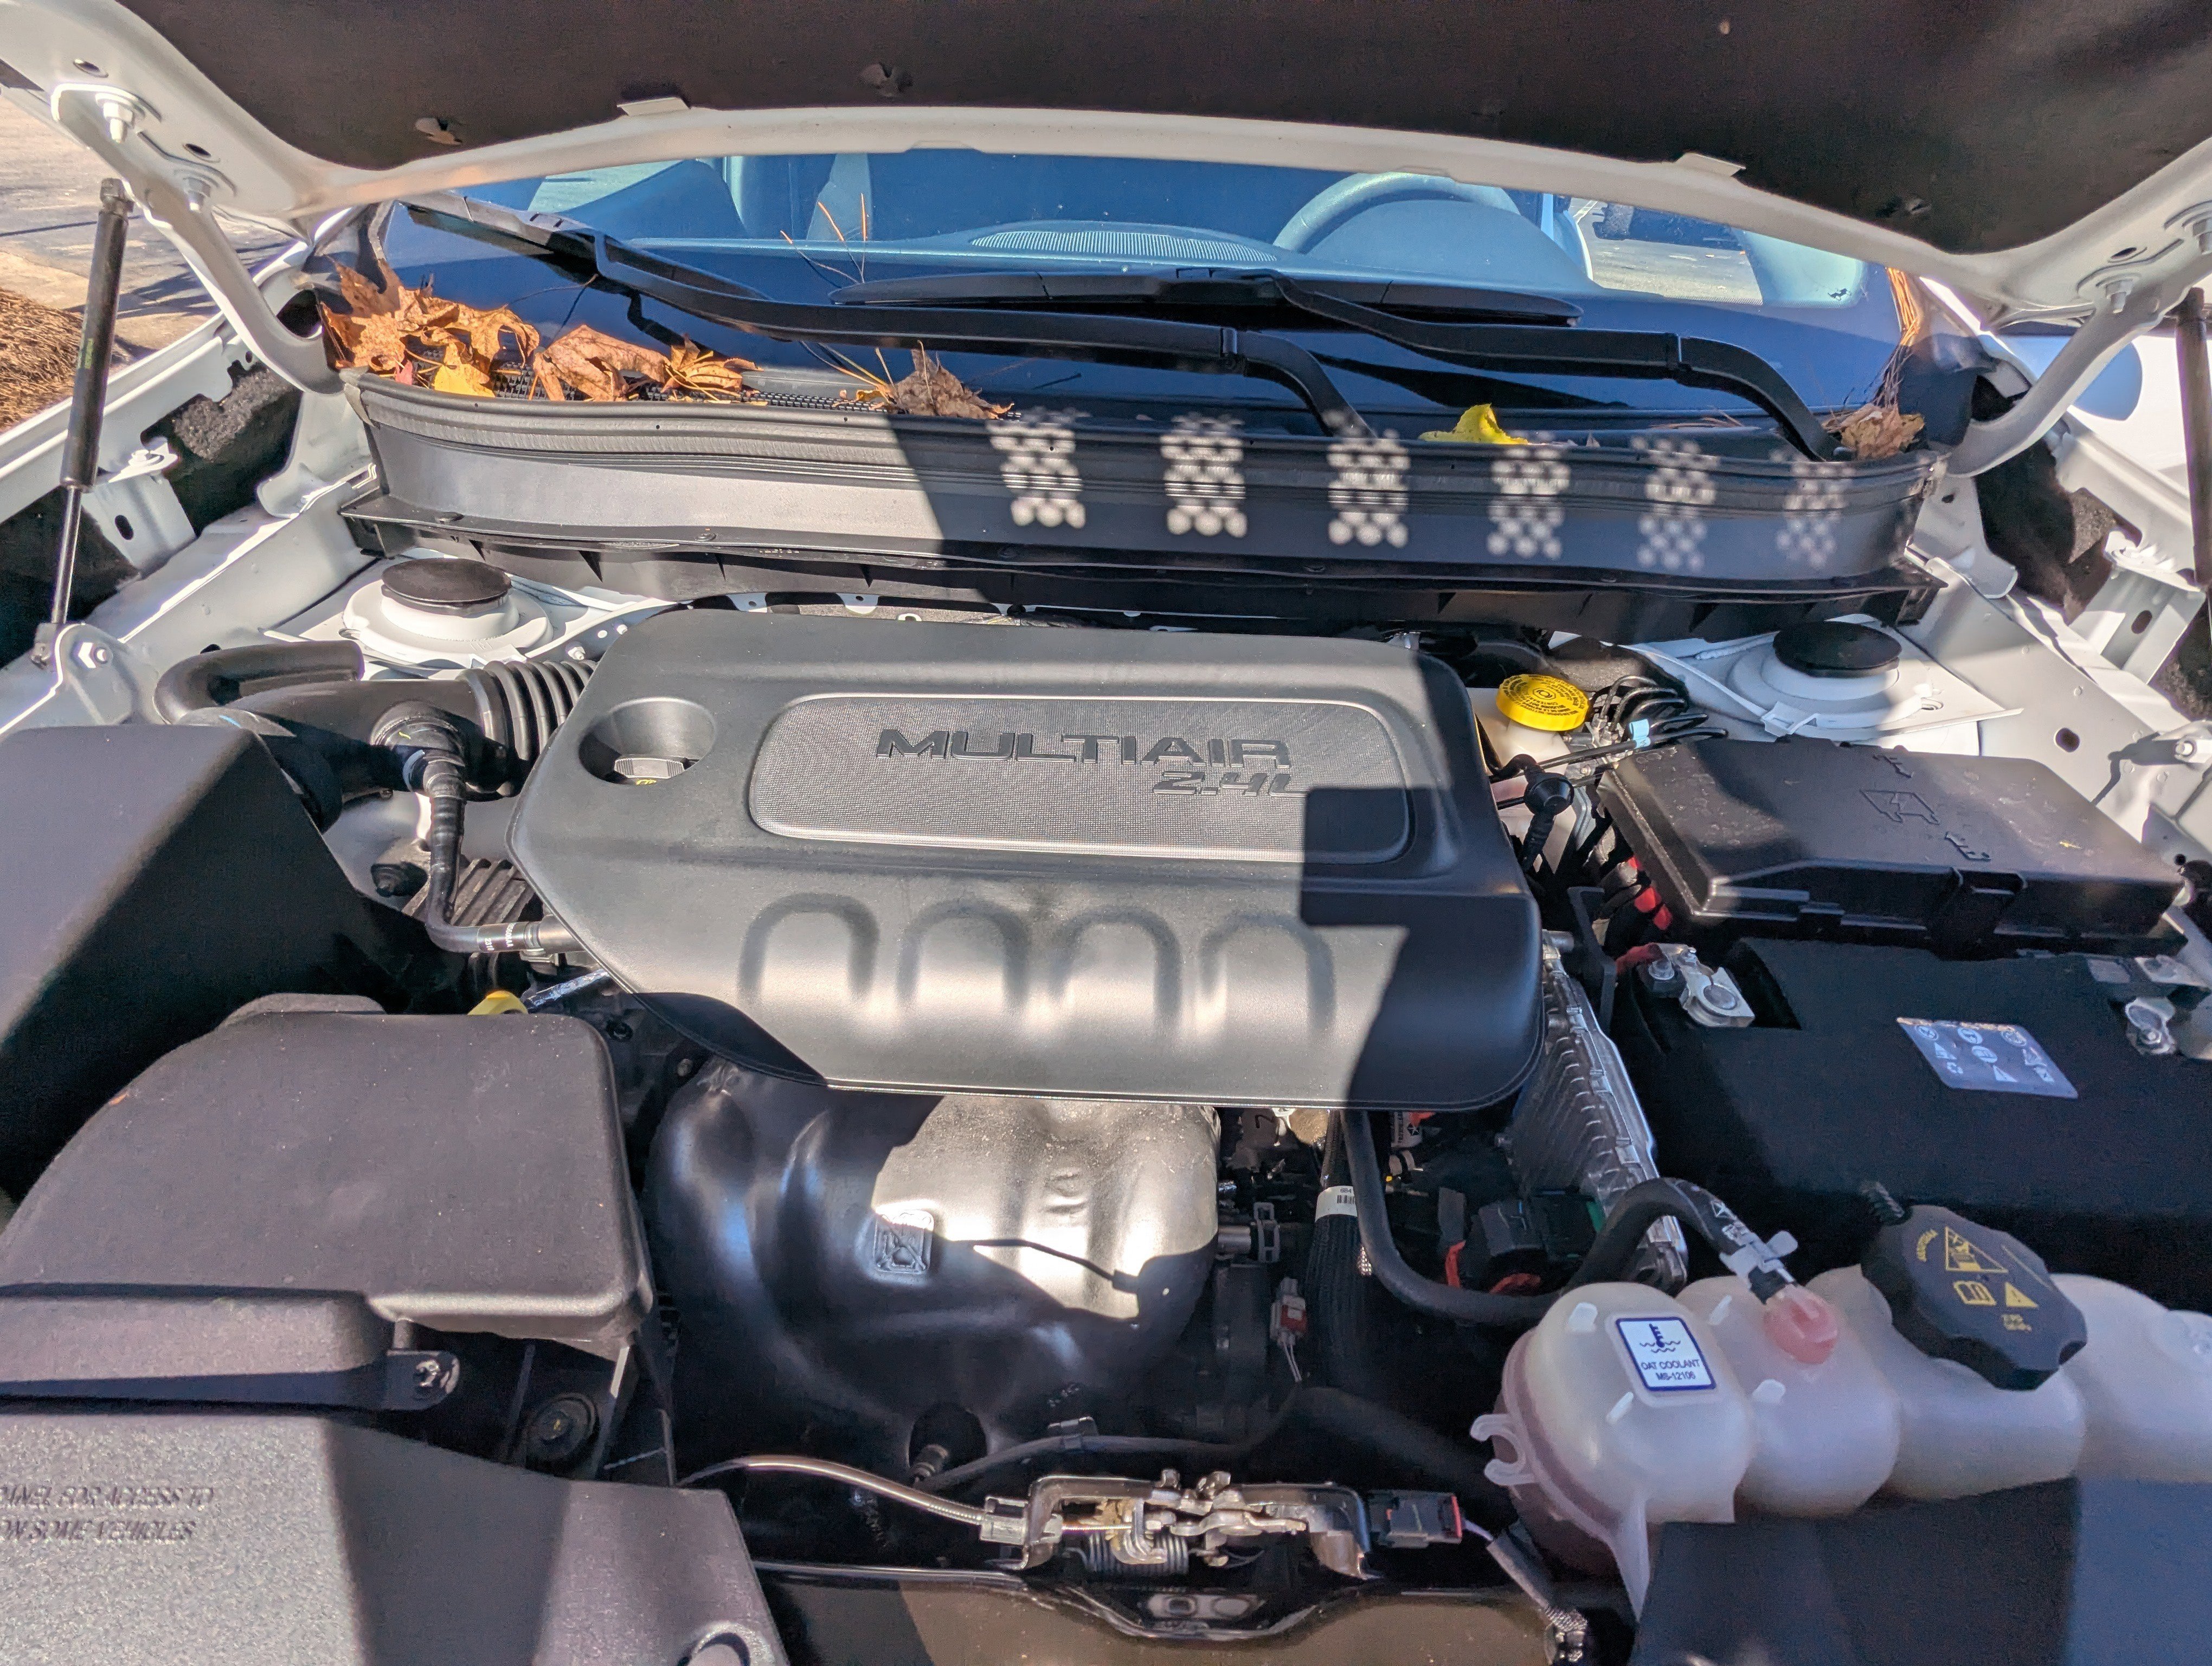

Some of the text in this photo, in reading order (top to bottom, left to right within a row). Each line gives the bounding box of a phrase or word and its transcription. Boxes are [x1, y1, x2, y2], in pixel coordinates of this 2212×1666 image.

[876, 728, 1291, 769] MULTIAIR
[1153, 770, 1309, 797] 2.4L
[1641, 1359, 1701, 1370] OAT COOLANT
[106, 1486, 184, 1507] ACCESS
[96, 1520, 197, 1541] VEHICLES
